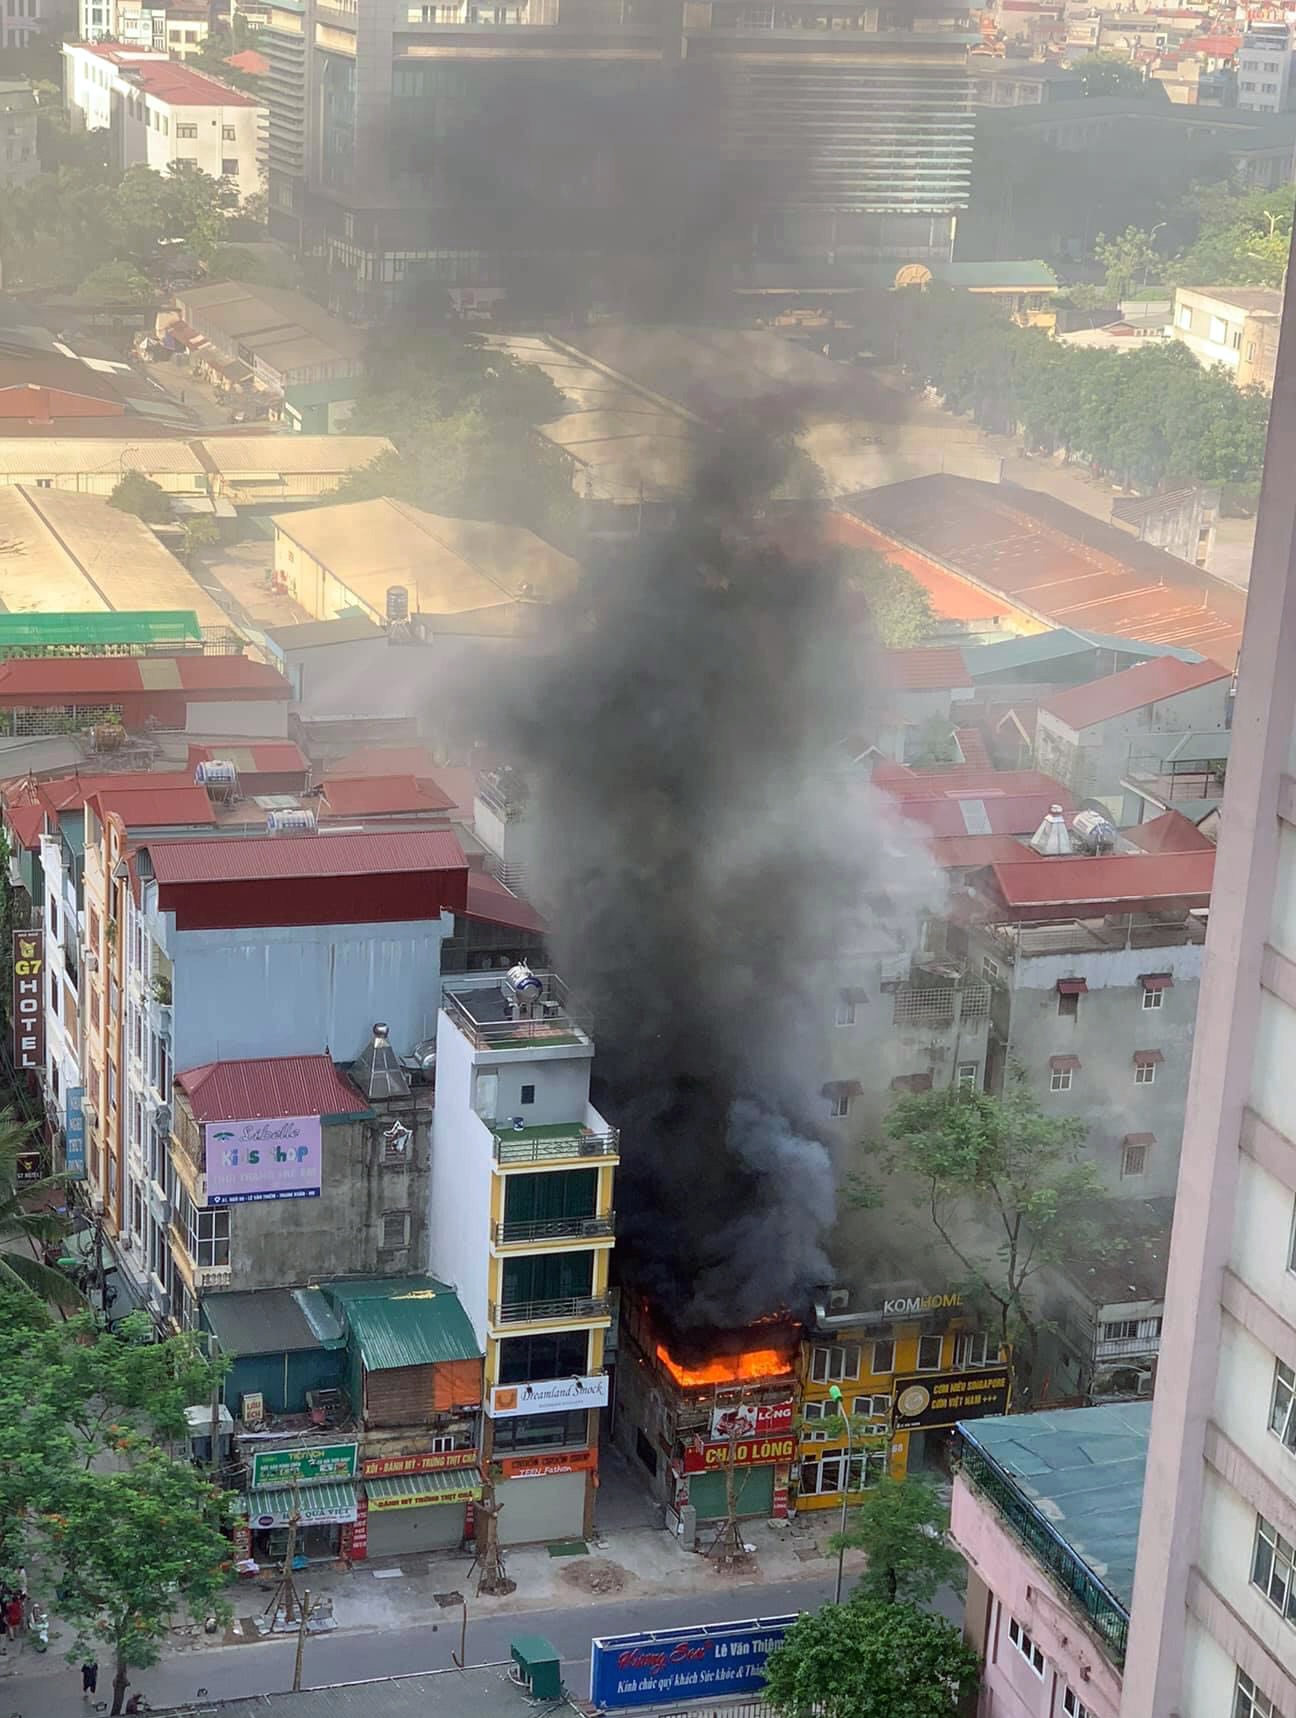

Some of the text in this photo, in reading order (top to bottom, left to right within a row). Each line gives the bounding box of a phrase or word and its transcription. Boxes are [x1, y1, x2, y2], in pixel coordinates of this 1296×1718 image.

[15, 959, 42, 975] G7
[19, 979, 37, 1067] HOTEL
[705, 1446, 748, 1463] CHO
[752, 1440, 793, 1458] LÒNG
[715, 1644, 728, 1659] Lê
[731, 1642, 750, 1656] Văn
[617, 1679, 639, 1694] Kính
[674, 1671, 699, 1687] khách
